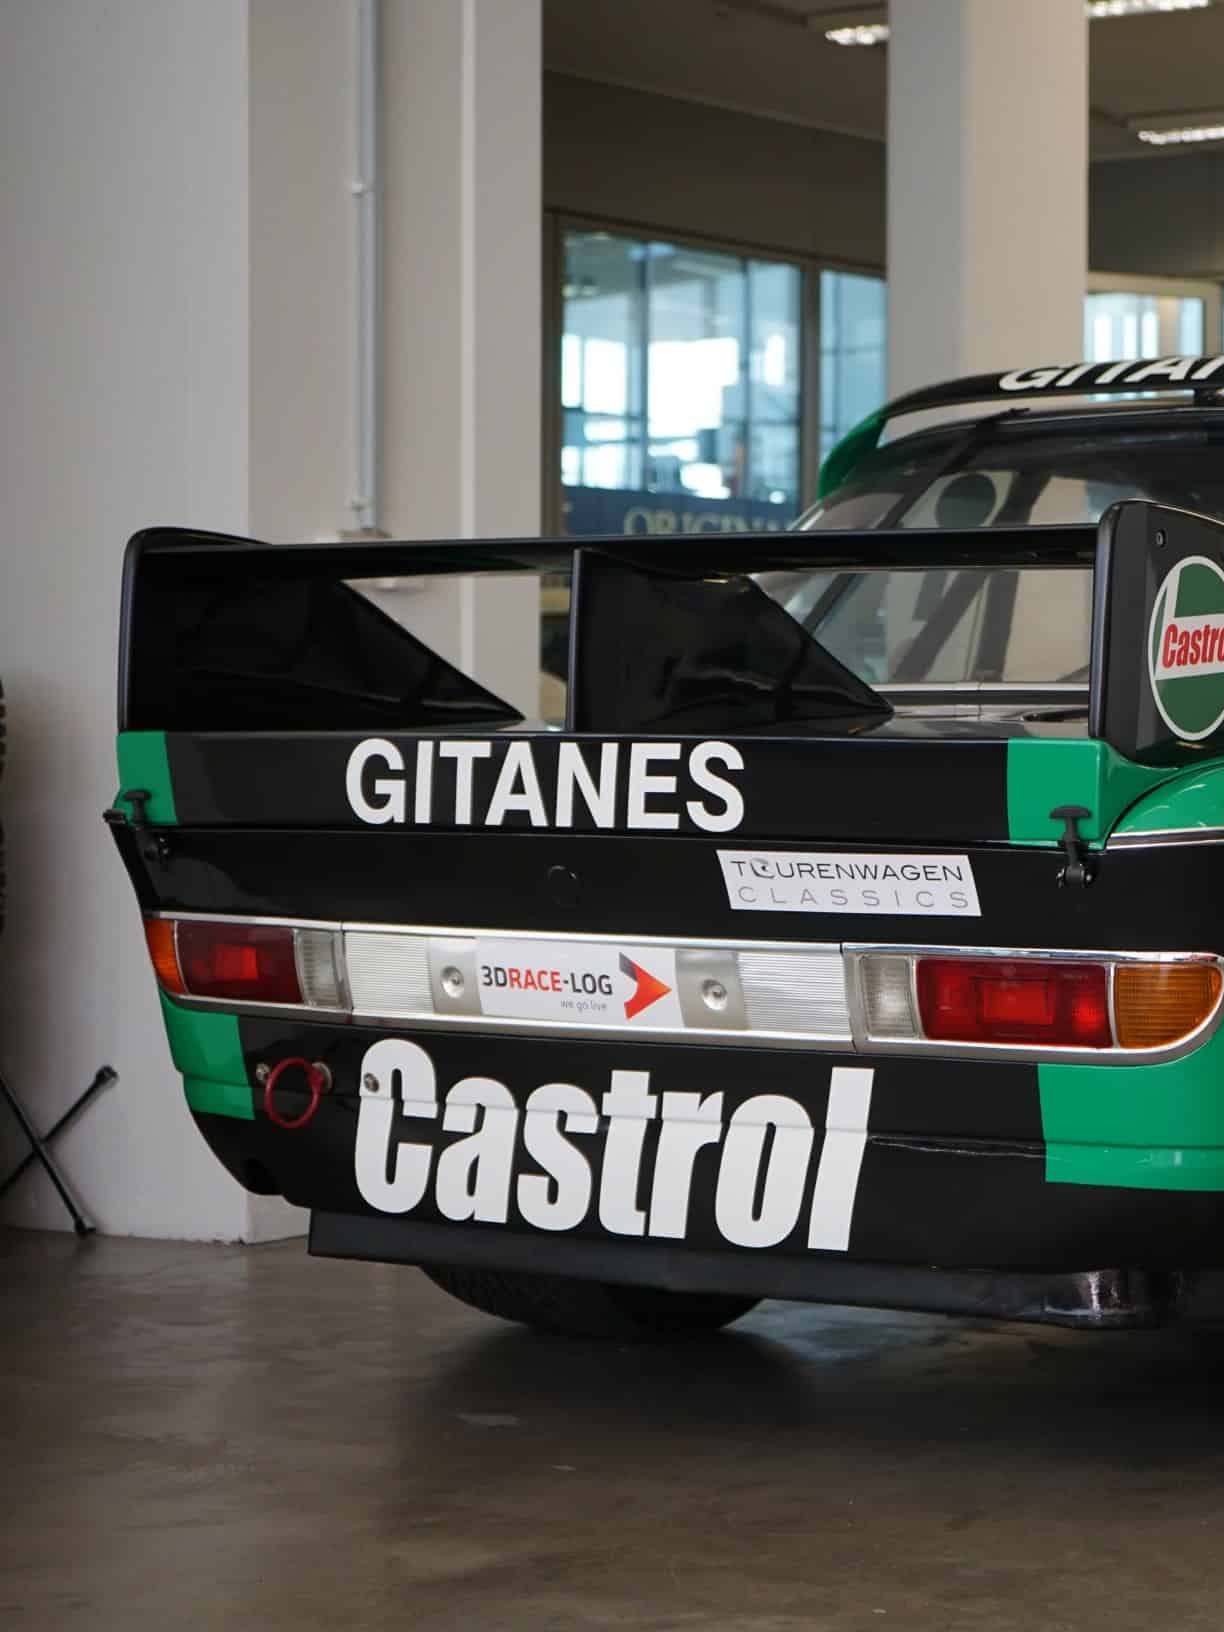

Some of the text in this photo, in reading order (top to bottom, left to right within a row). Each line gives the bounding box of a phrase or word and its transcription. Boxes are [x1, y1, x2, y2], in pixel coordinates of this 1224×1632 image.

[345, 738, 745, 832] GITANES
[730, 857, 963, 882] TOURENWAGEN
[738, 886, 969, 909] CLASSICS
[481, 965, 614, 996] 3DRACE-LOG
[560, 1000, 574, 1009] we
[355, 1038, 875, 1252] Castrol
